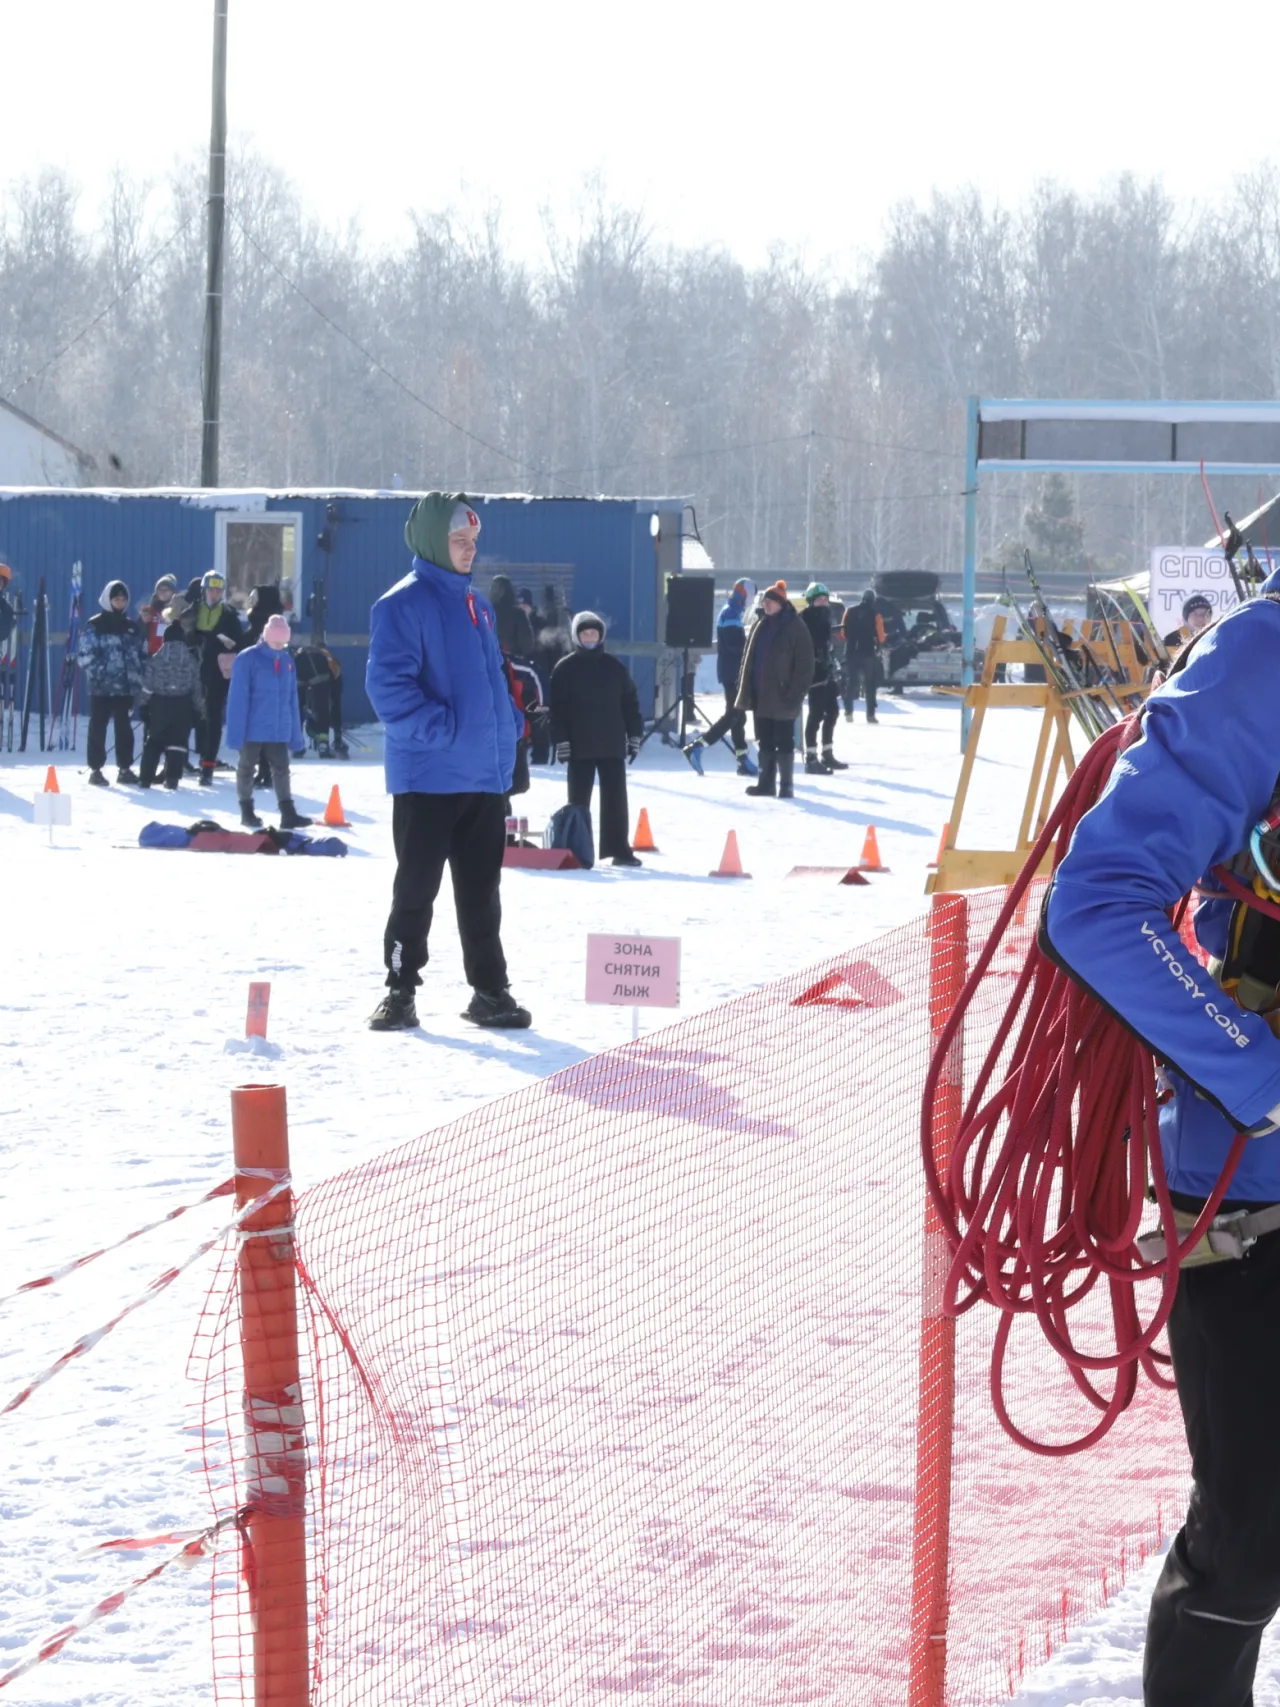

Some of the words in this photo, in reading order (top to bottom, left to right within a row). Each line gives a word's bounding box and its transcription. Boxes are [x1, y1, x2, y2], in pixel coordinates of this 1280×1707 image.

[614, 942, 653, 957] ЗОНА
[604, 962, 661, 978] СНЯТИЯ
[613, 983, 650, 998] ЛЫЖ
[1140, 920, 1206, 999] VICTORY
[1204, 1002, 1250, 1048] CODE
